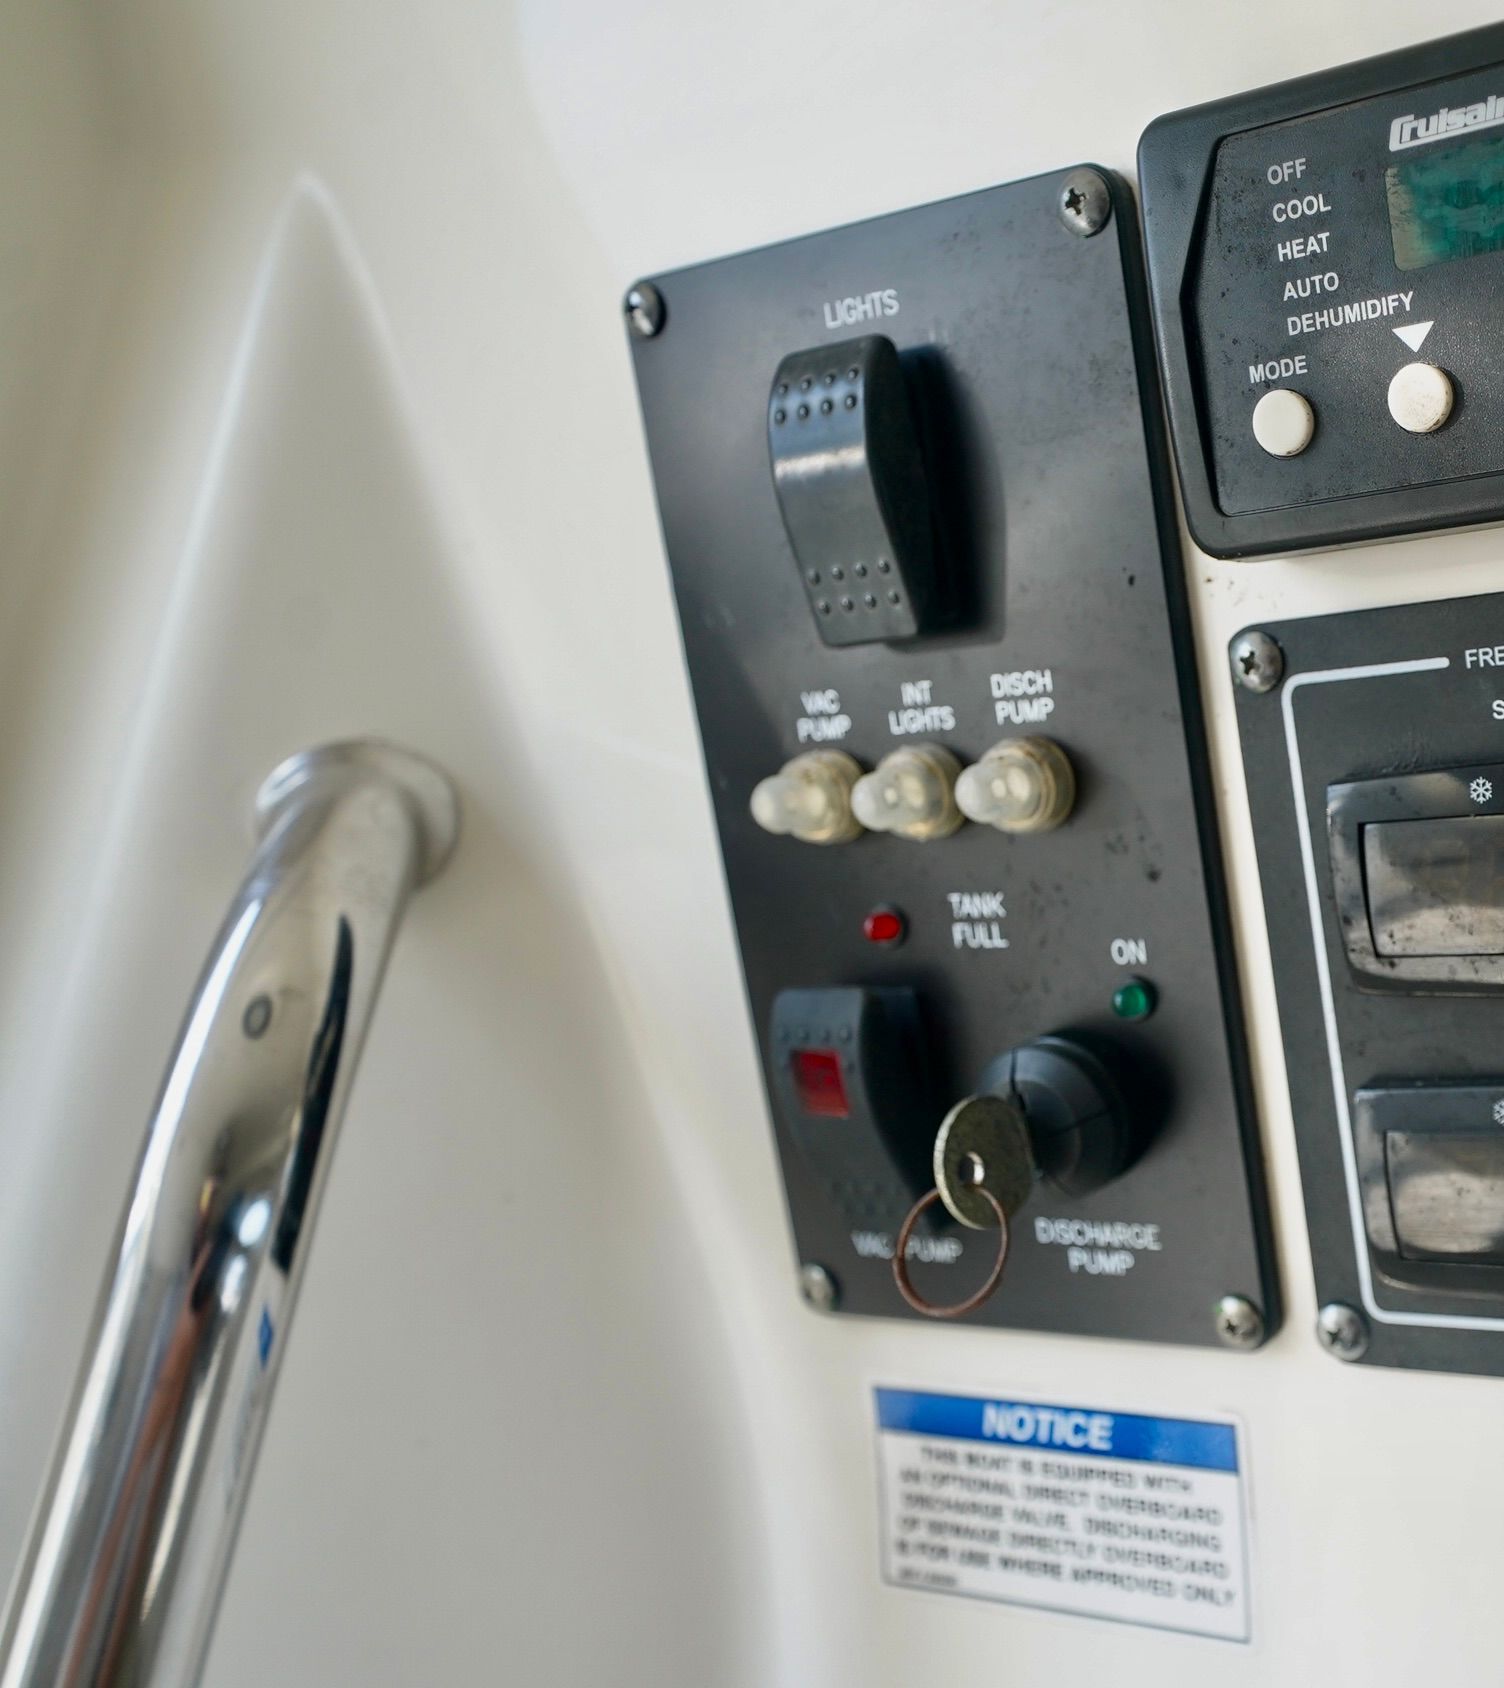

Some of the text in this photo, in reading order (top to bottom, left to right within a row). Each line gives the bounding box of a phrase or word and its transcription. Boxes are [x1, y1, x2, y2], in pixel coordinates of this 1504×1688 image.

[1266, 157, 1308, 186] OFF
[1271, 193, 1332, 223] COOL
[1277, 232, 1331, 262] HEAT
[1283, 271, 1340, 302] AUTO
[824, 287, 900, 330] LIGHTS
[1286, 291, 1415, 337] DEHUMIDIFY
[1248, 355, 1308, 385] MODE
[901, 680, 933, 704] INT
[990, 669, 1053, 699] DISCH
[801, 688, 840, 714] VAC
[994, 697, 1055, 726] PUMP
[797, 713, 853, 743] PUMP
[888, 704, 956, 734] LIGHTS
[947, 893, 1007, 919] TANK
[953, 921, 1009, 949] FULL
[1111, 939, 1148, 965] ON
[851, 1231, 964, 1264] VAC PUMP
[1034, 1216, 1163, 1251] DISCHARGE
[1067, 1246, 1136, 1276] PUMP
[982, 1402, 1113, 1451] NOTICE
[1042, 1461, 1136, 1489] EQUIPPED
[1144, 1474, 1193, 1494] WITH
[928, 1472, 1016, 1499] OPTIONAL
[1025, 1484, 1090, 1508] DIRECT
[1096, 1494, 1223, 1527] OVERBOARD
[1084, 1517, 1222, 1554] DISCHARGING
[1102, 1545, 1231, 1580] OVERBOARD
